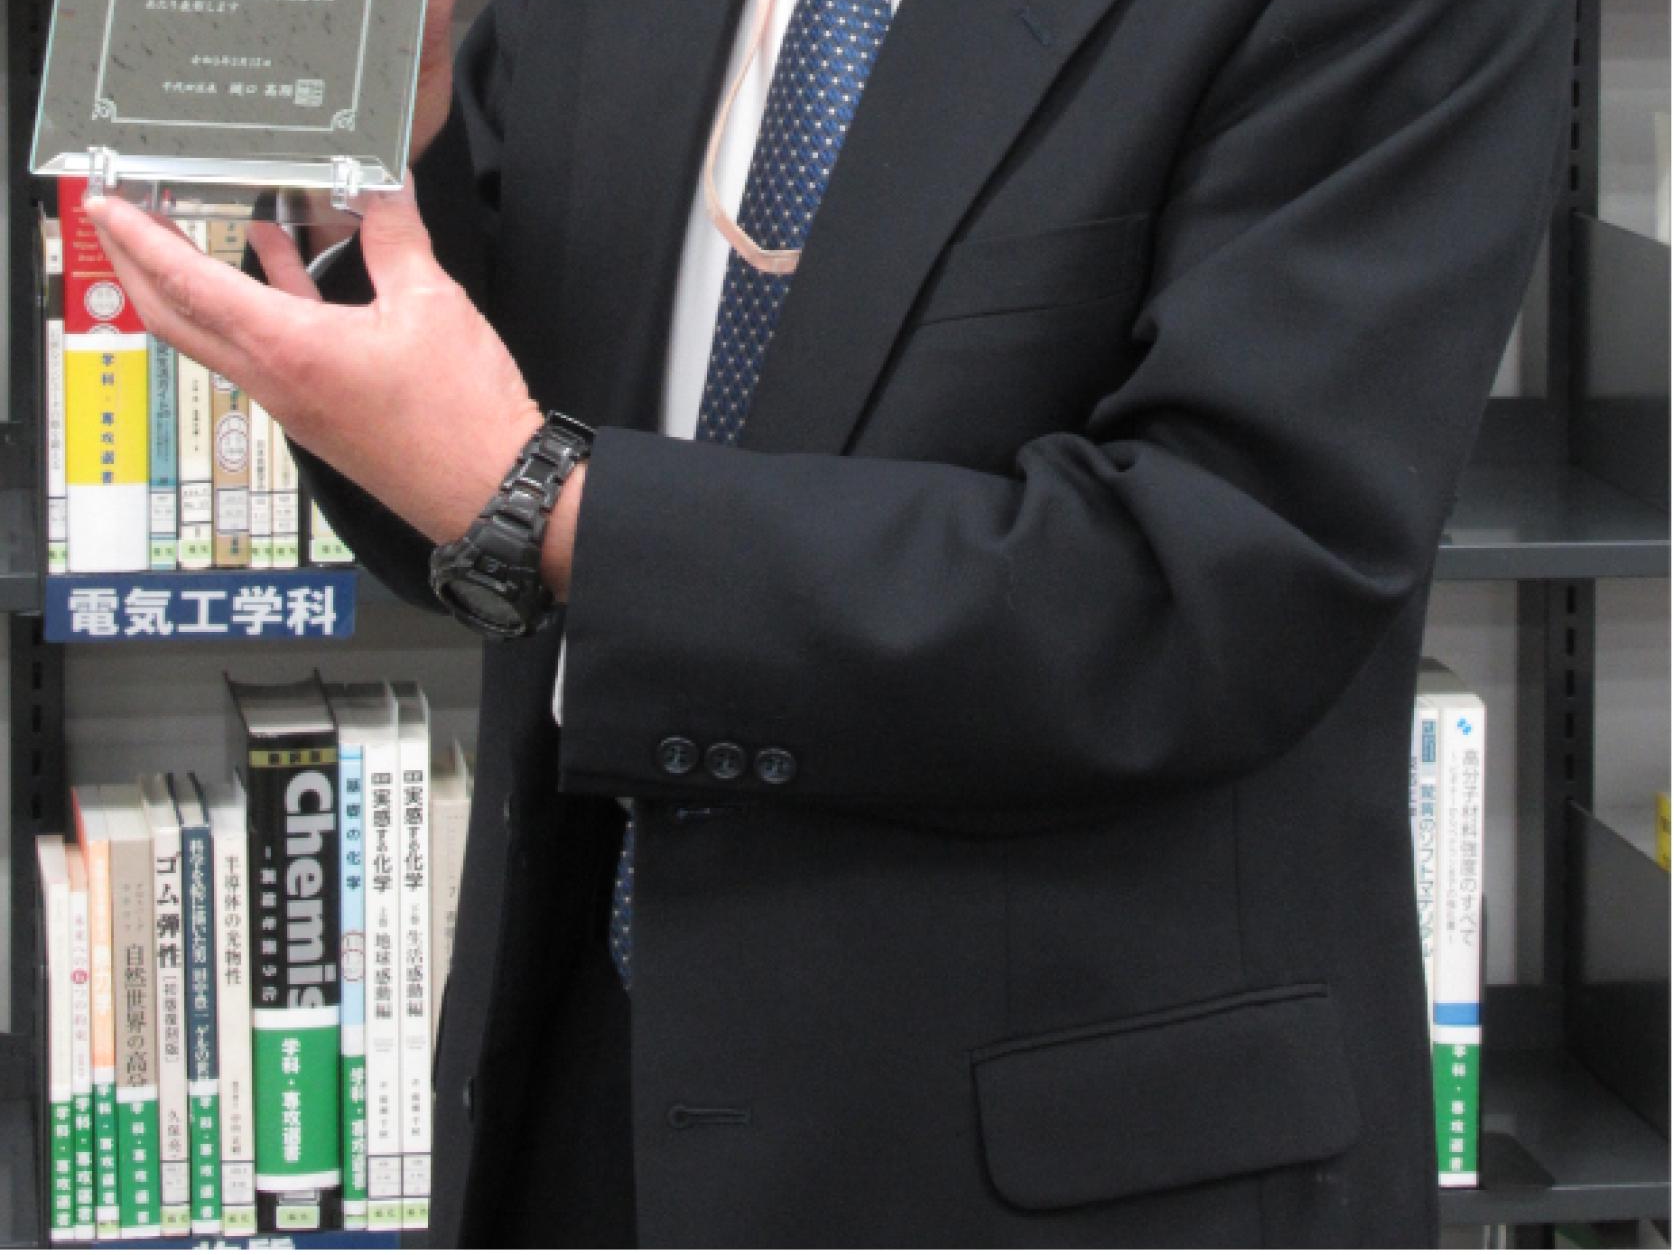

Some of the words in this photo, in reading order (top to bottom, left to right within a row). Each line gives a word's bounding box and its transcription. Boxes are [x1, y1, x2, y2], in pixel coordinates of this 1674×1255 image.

[68, 586, 336, 636] 電気工学科
[156, 853, 181, 968] ゴム弾性
